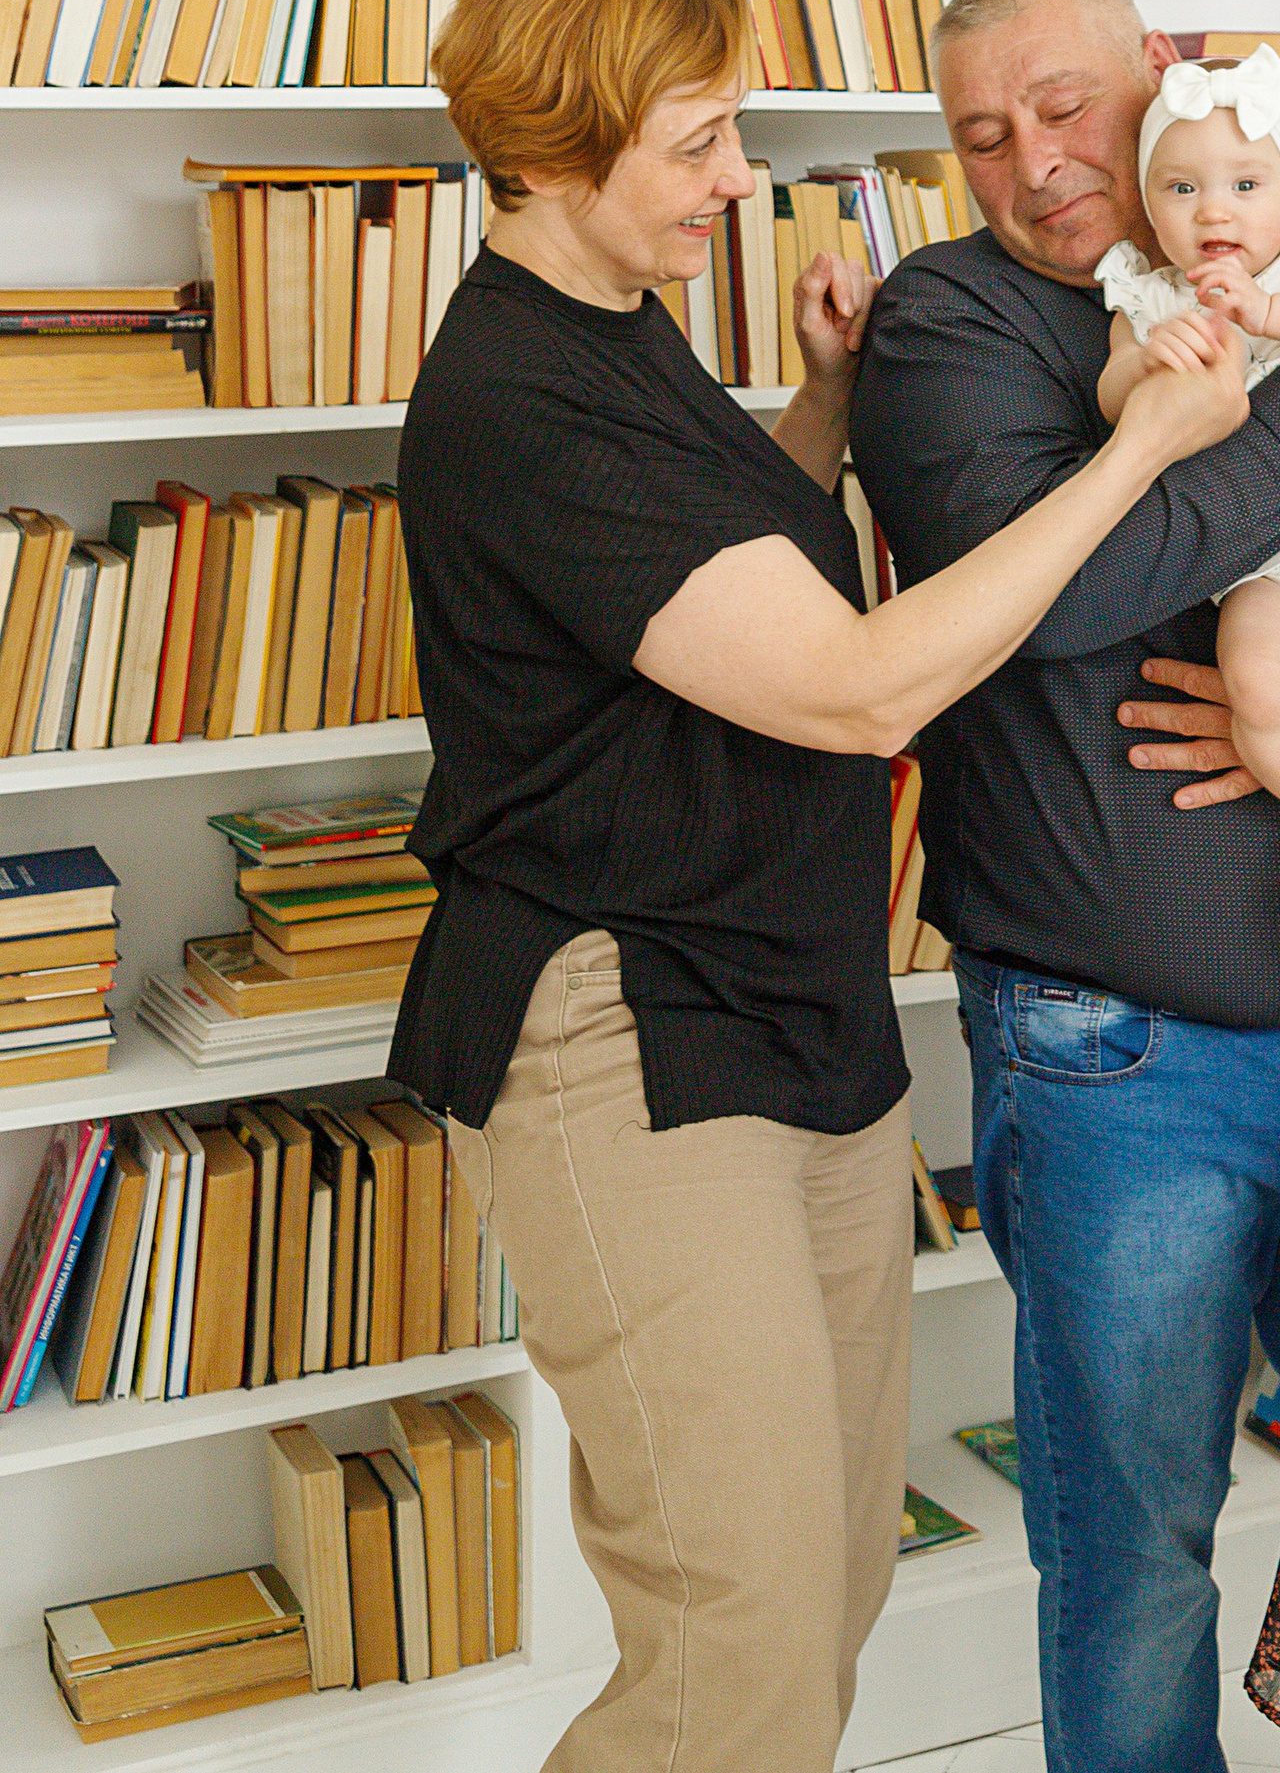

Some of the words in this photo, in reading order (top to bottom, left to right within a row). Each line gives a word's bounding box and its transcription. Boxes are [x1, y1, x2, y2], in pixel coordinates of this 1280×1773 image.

[66, 1245, 79, 1262] ИКТ
[62, 1259, 72, 1270] И
[39, 1271, 69, 1341] ИНФОРМАТИКА
